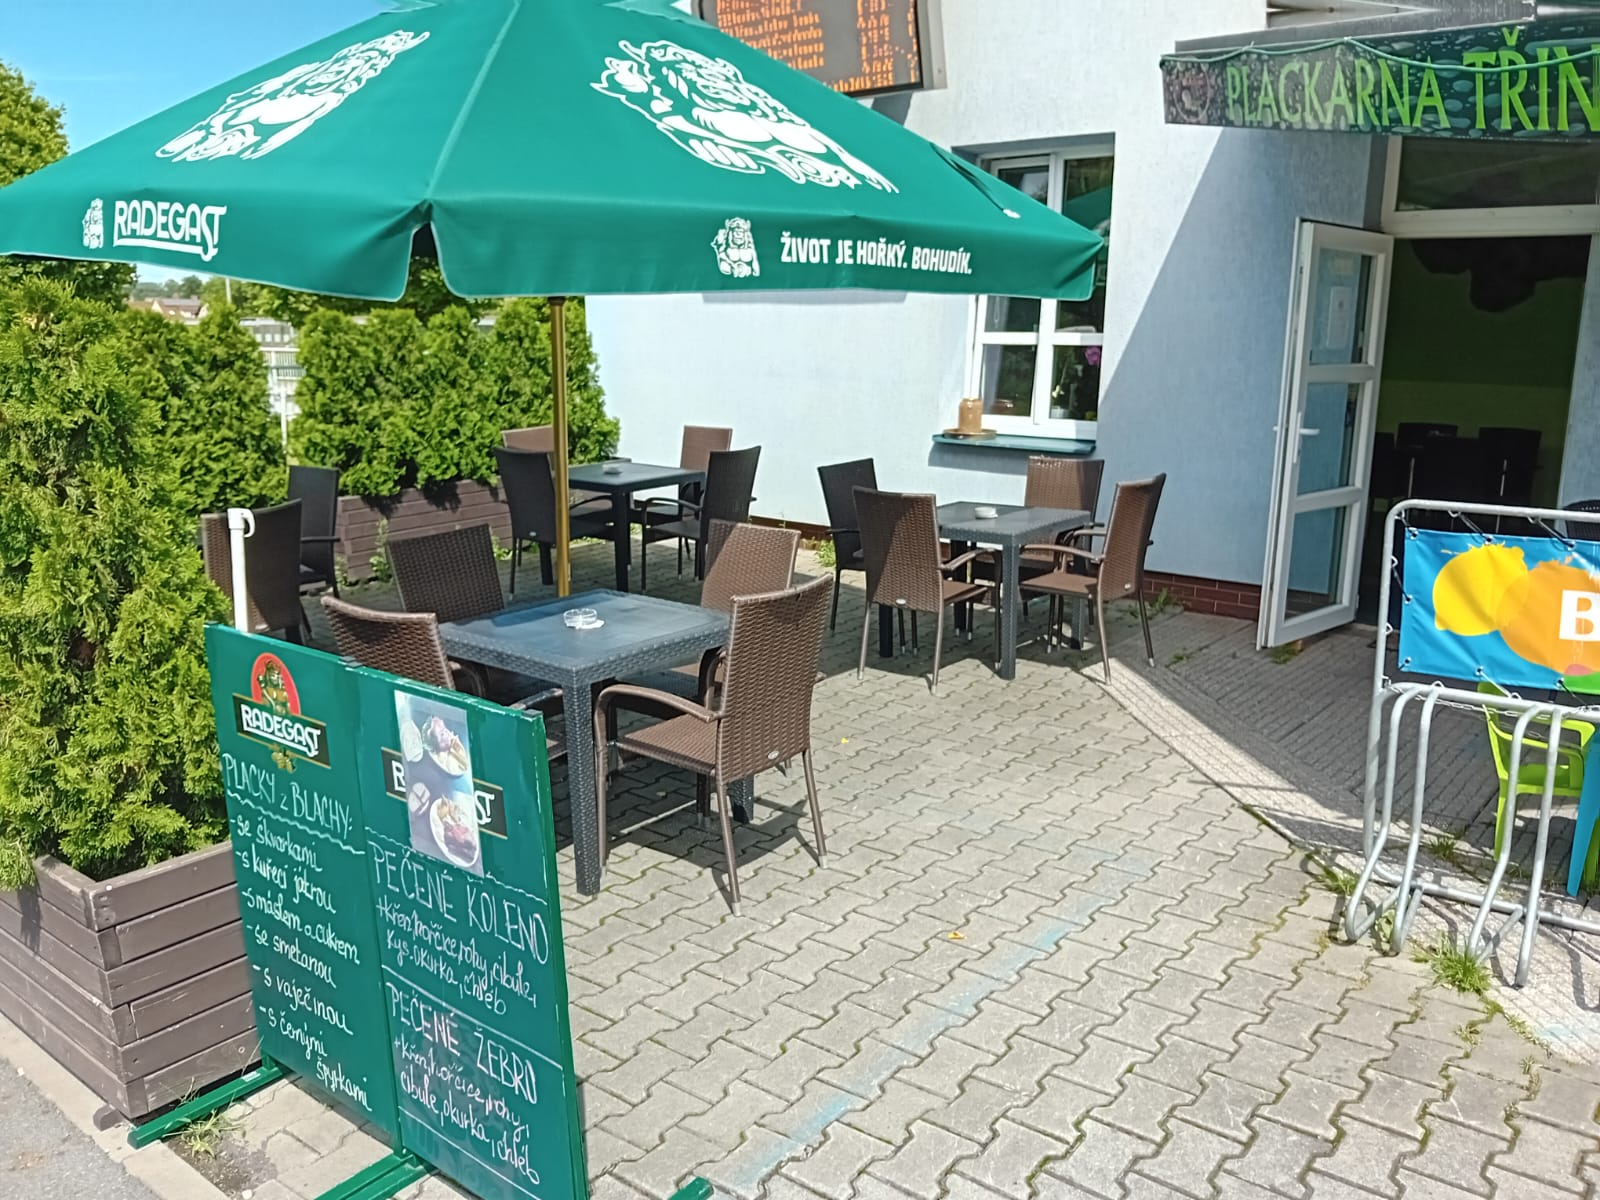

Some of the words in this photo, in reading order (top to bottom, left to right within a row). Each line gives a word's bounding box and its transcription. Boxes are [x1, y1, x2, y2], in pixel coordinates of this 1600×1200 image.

[113, 199, 227, 262] RADEGAST
[780, 232, 831, 264] ŽIVOT
[835, 239, 853, 265] JE
[856, 237, 907, 269] HOŘKÝ.
[911, 247, 972, 275] BOHUDÍK.
[240, 703, 321, 758] RADEGAST
[222, 752, 276, 804] PLACKY
[368, 840, 457, 923] PEČENÉ
[466, 884, 549, 965] KOLENO
[273, 937, 337, 989] smetanou
[474, 1028, 538, 1105] ŽEBRO
